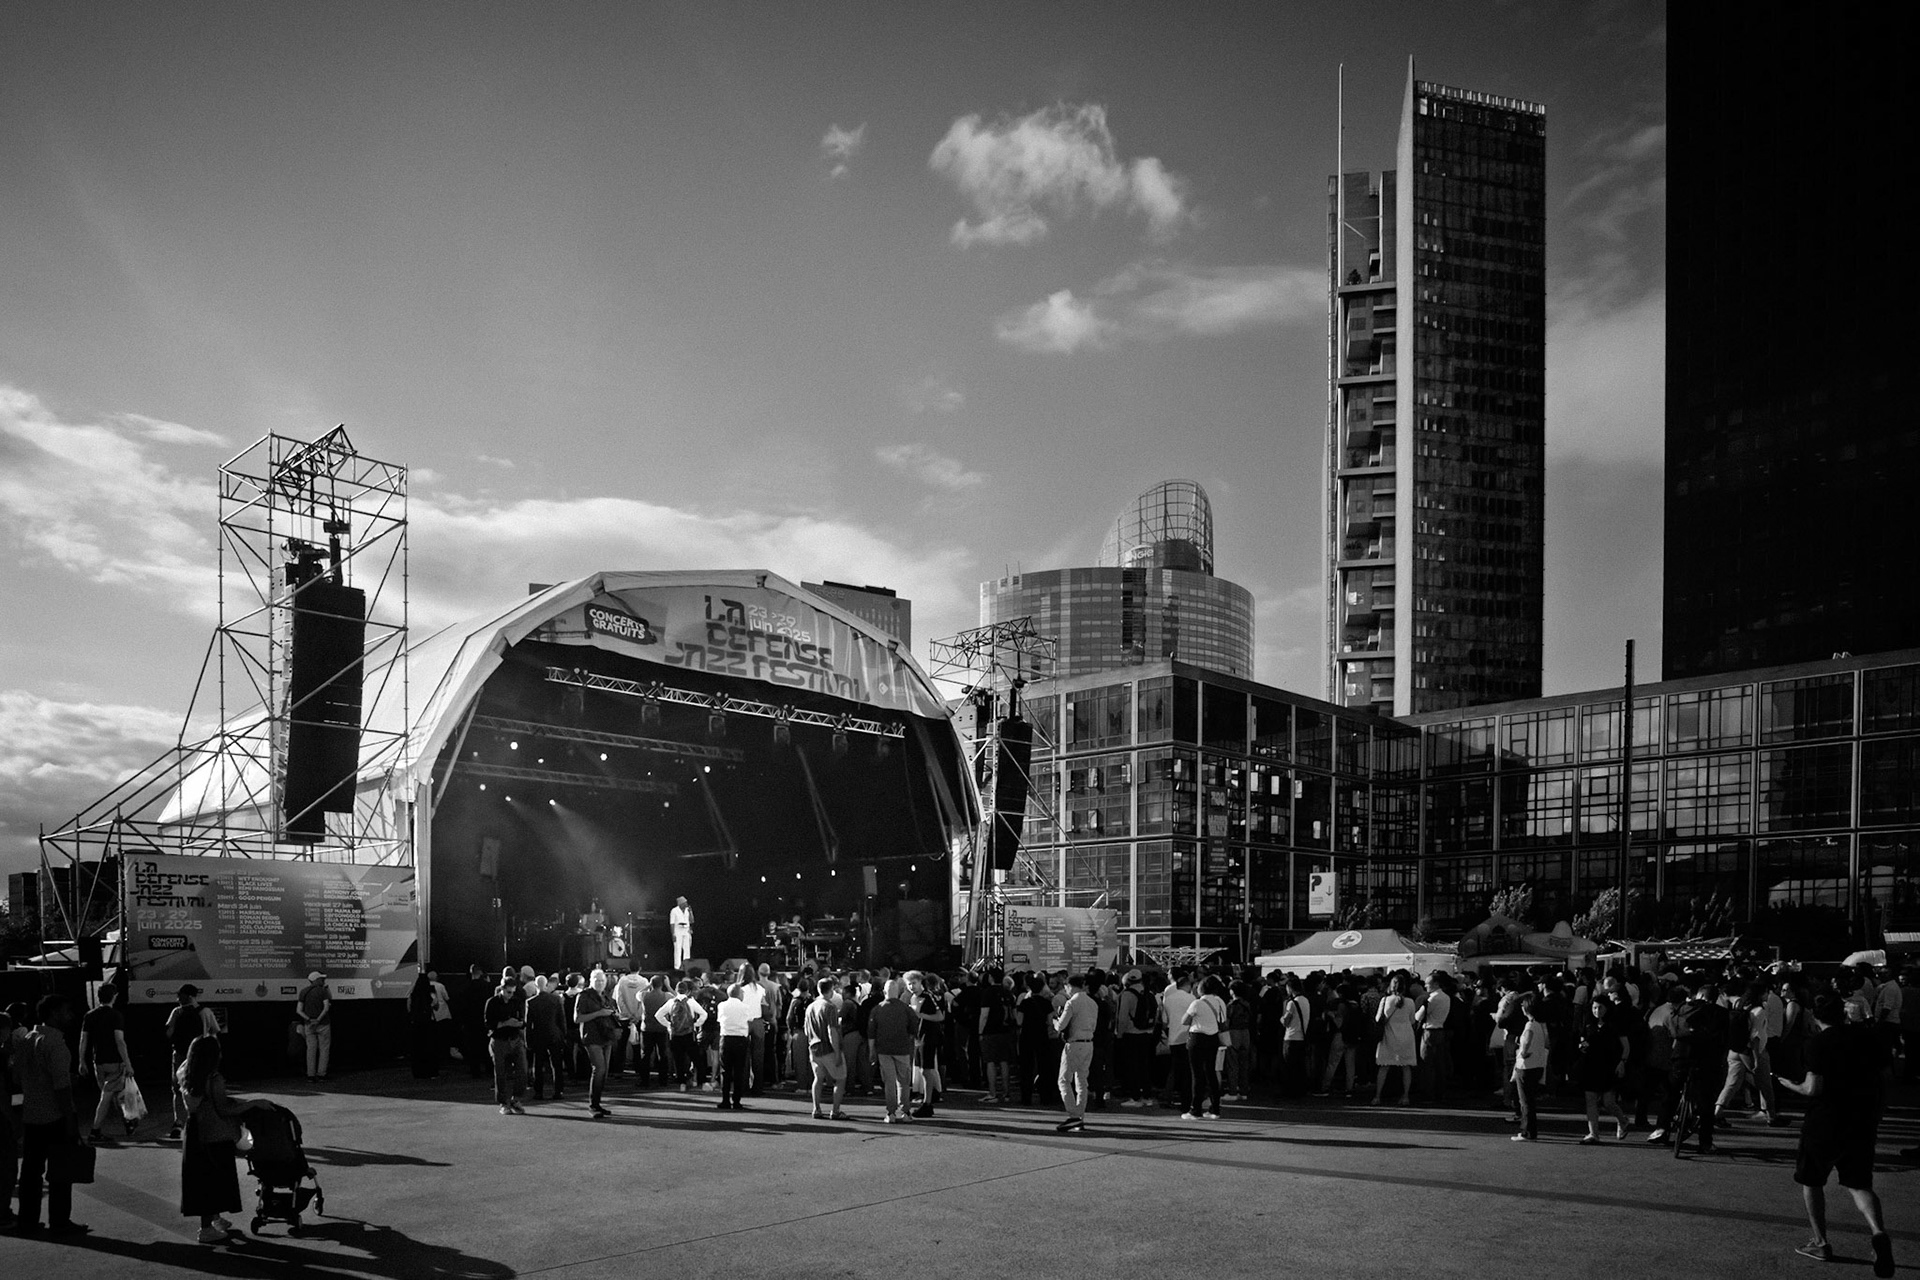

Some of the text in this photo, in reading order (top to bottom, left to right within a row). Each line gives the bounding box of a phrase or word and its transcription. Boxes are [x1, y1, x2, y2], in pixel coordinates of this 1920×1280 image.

[705, 596, 745, 626] LA
[748, 605, 767, 619] 23
[589, 608, 646, 632] CONCERTS
[592, 618, 645, 639] GRATUITS
[748, 616, 812, 642] juin 2025
[664, 642, 870, 703] JAZZ FESTIVAL
[134, 862, 158, 873] LA
[129, 884, 172, 896] JAZZ
[1312, 875, 1322, 892] P
[136, 896, 212, 908] FESTIVAL
[136, 910, 156, 920] 23
[168, 910, 188, 920] 29
[137, 918, 203, 932] juin 2025
